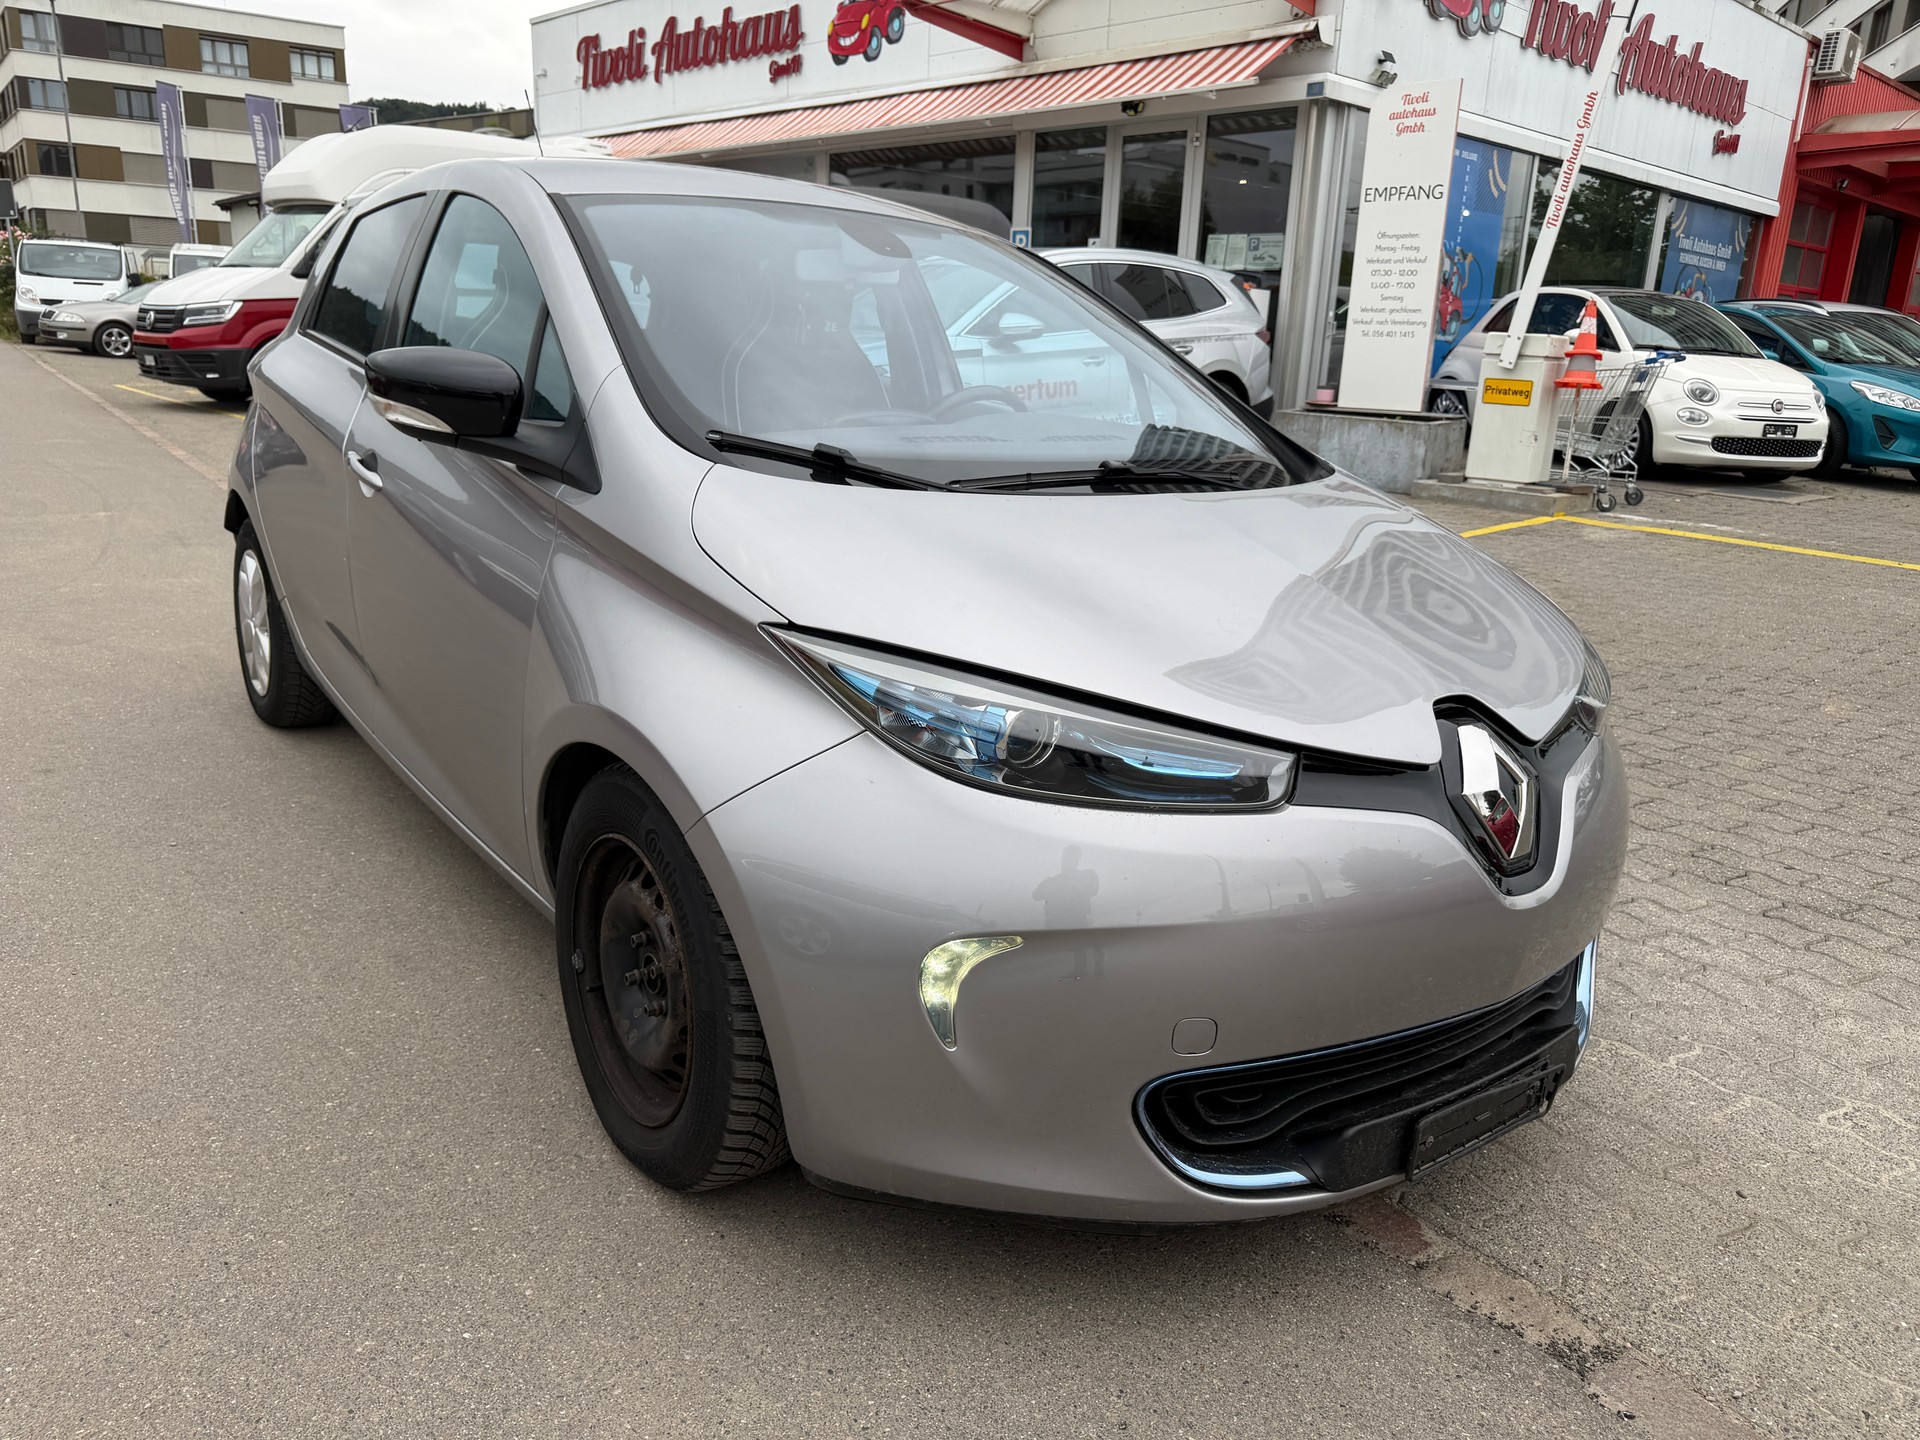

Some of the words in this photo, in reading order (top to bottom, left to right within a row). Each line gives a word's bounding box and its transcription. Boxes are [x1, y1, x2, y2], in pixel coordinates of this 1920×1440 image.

[576, 26, 650, 90] Tivoli
[651, 4, 805, 84] Autohaus
[1617, 12, 1749, 126] Autohaus
[1401, 91, 1430, 106] Tivoli
[1389, 107, 1436, 121] autohaus
[1395, 122, 1425, 137] Gmbh
[1546, 194, 1566, 229] Tivoli
[1560, 133, 1584, 193] autohaus
[1576, 90, 1599, 129] Gmbh
[1364, 183, 1444, 202] EMPFANG
[1376, 231, 1421, 241] Öffnungszeiten:
[1375, 244, 1397, 253] Montag
[1400, 244, 1420, 253] Freitag
[1678, 233, 1695, 250] Tivoli
[1692, 237, 1717, 257] Autohaus
[1393, 256, 1404, 264] und
[1405, 256, 1428, 264] Verkauf
[1380, 294, 1403, 303] Samstag
[1388, 306, 1421, 315] geschlossen
[1390, 318, 1427, 328] Vereinbarung
[1484, 385, 1530, 399] Privatweg
[644, 828, 703, 967] Continental
